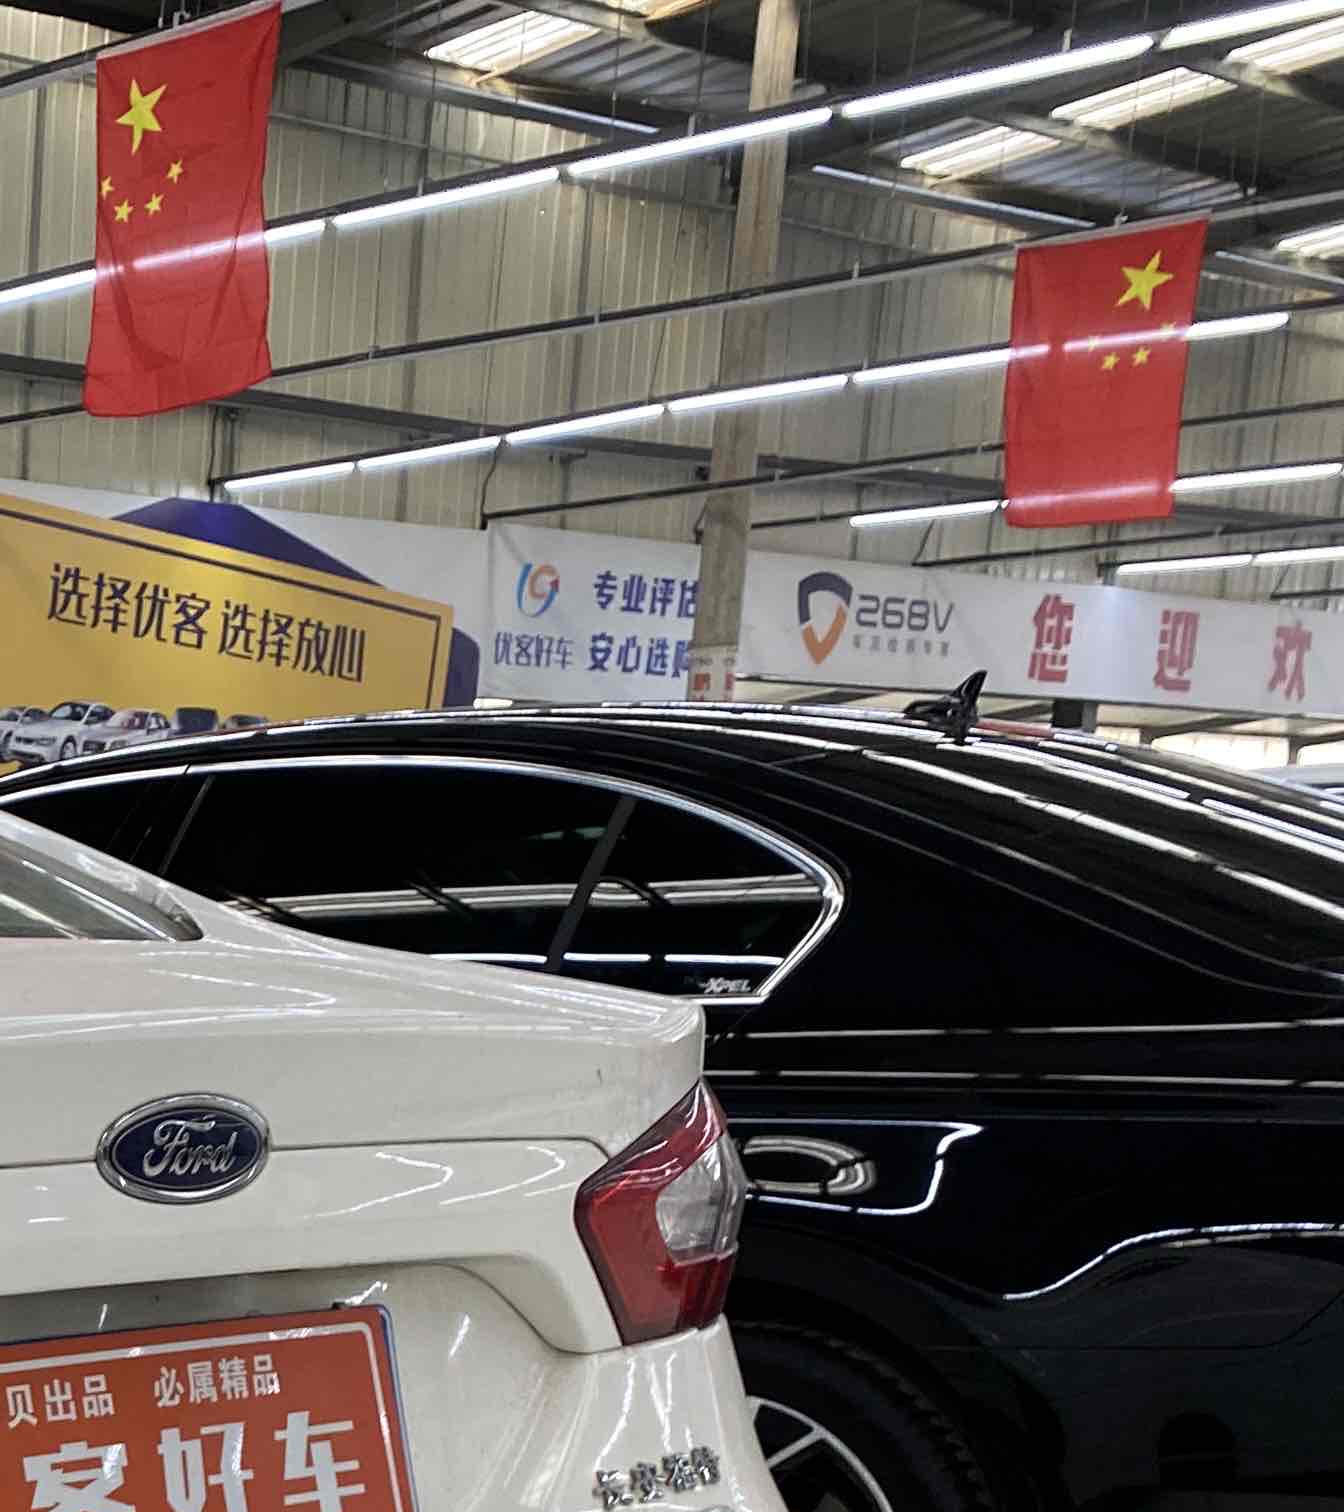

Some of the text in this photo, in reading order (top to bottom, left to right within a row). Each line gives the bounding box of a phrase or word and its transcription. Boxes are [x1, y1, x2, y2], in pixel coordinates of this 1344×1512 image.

[47, 562, 367, 683] 选择优客 选择放心
[855, 594, 954, 634] 268V
[494, 631, 575, 670] 优客好车
[143, 1114, 239, 1177] Ford
[153, 1353, 282, 1409] 必属精品
